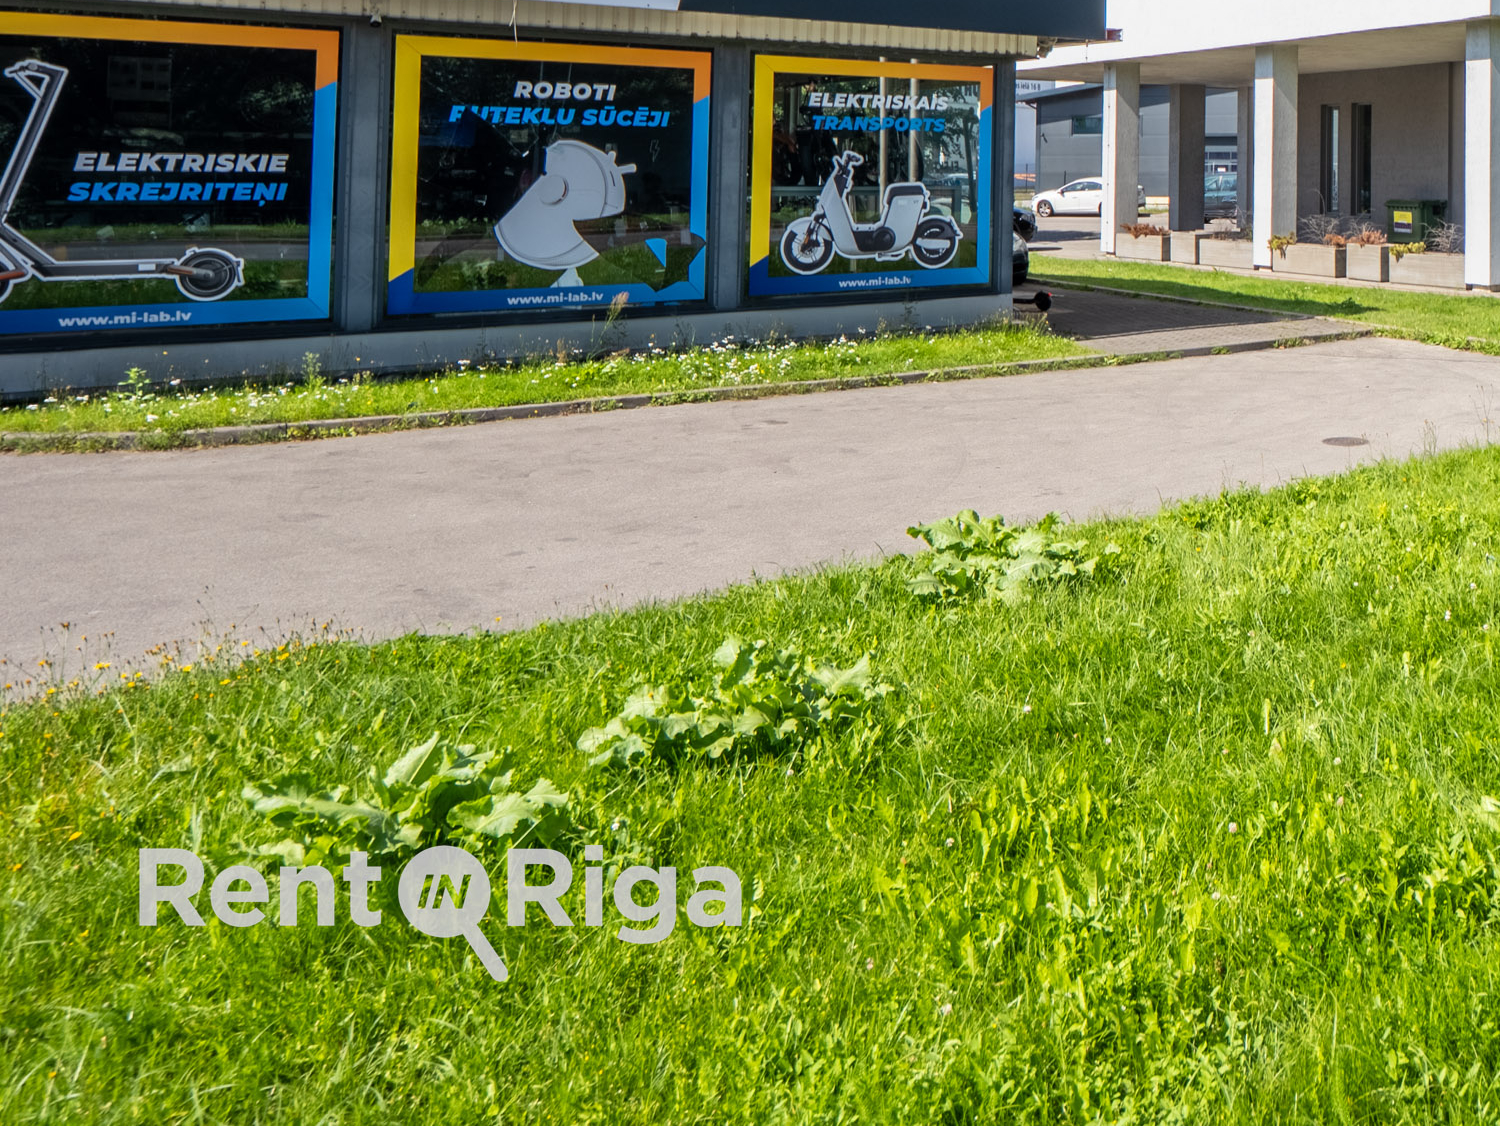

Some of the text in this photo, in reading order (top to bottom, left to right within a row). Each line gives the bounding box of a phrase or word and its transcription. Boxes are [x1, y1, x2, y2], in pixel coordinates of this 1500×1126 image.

[513, 80, 617, 102] ROBOTI
[808, 92, 949, 111] ELEKTRISKAIS
[581, 105, 671, 128] SŪCĒJI
[812, 114, 946, 133] TRANSPORTS
[73, 151, 290, 173] ELEKTRISKIE
[67, 181, 289, 208] SKREJRITEŅI
[838, 275, 912, 288] www.mi-lab.lv
[507, 291, 604, 306] www.mi-lab.lv
[58, 310, 192, 328] www.mi-lab.lv
